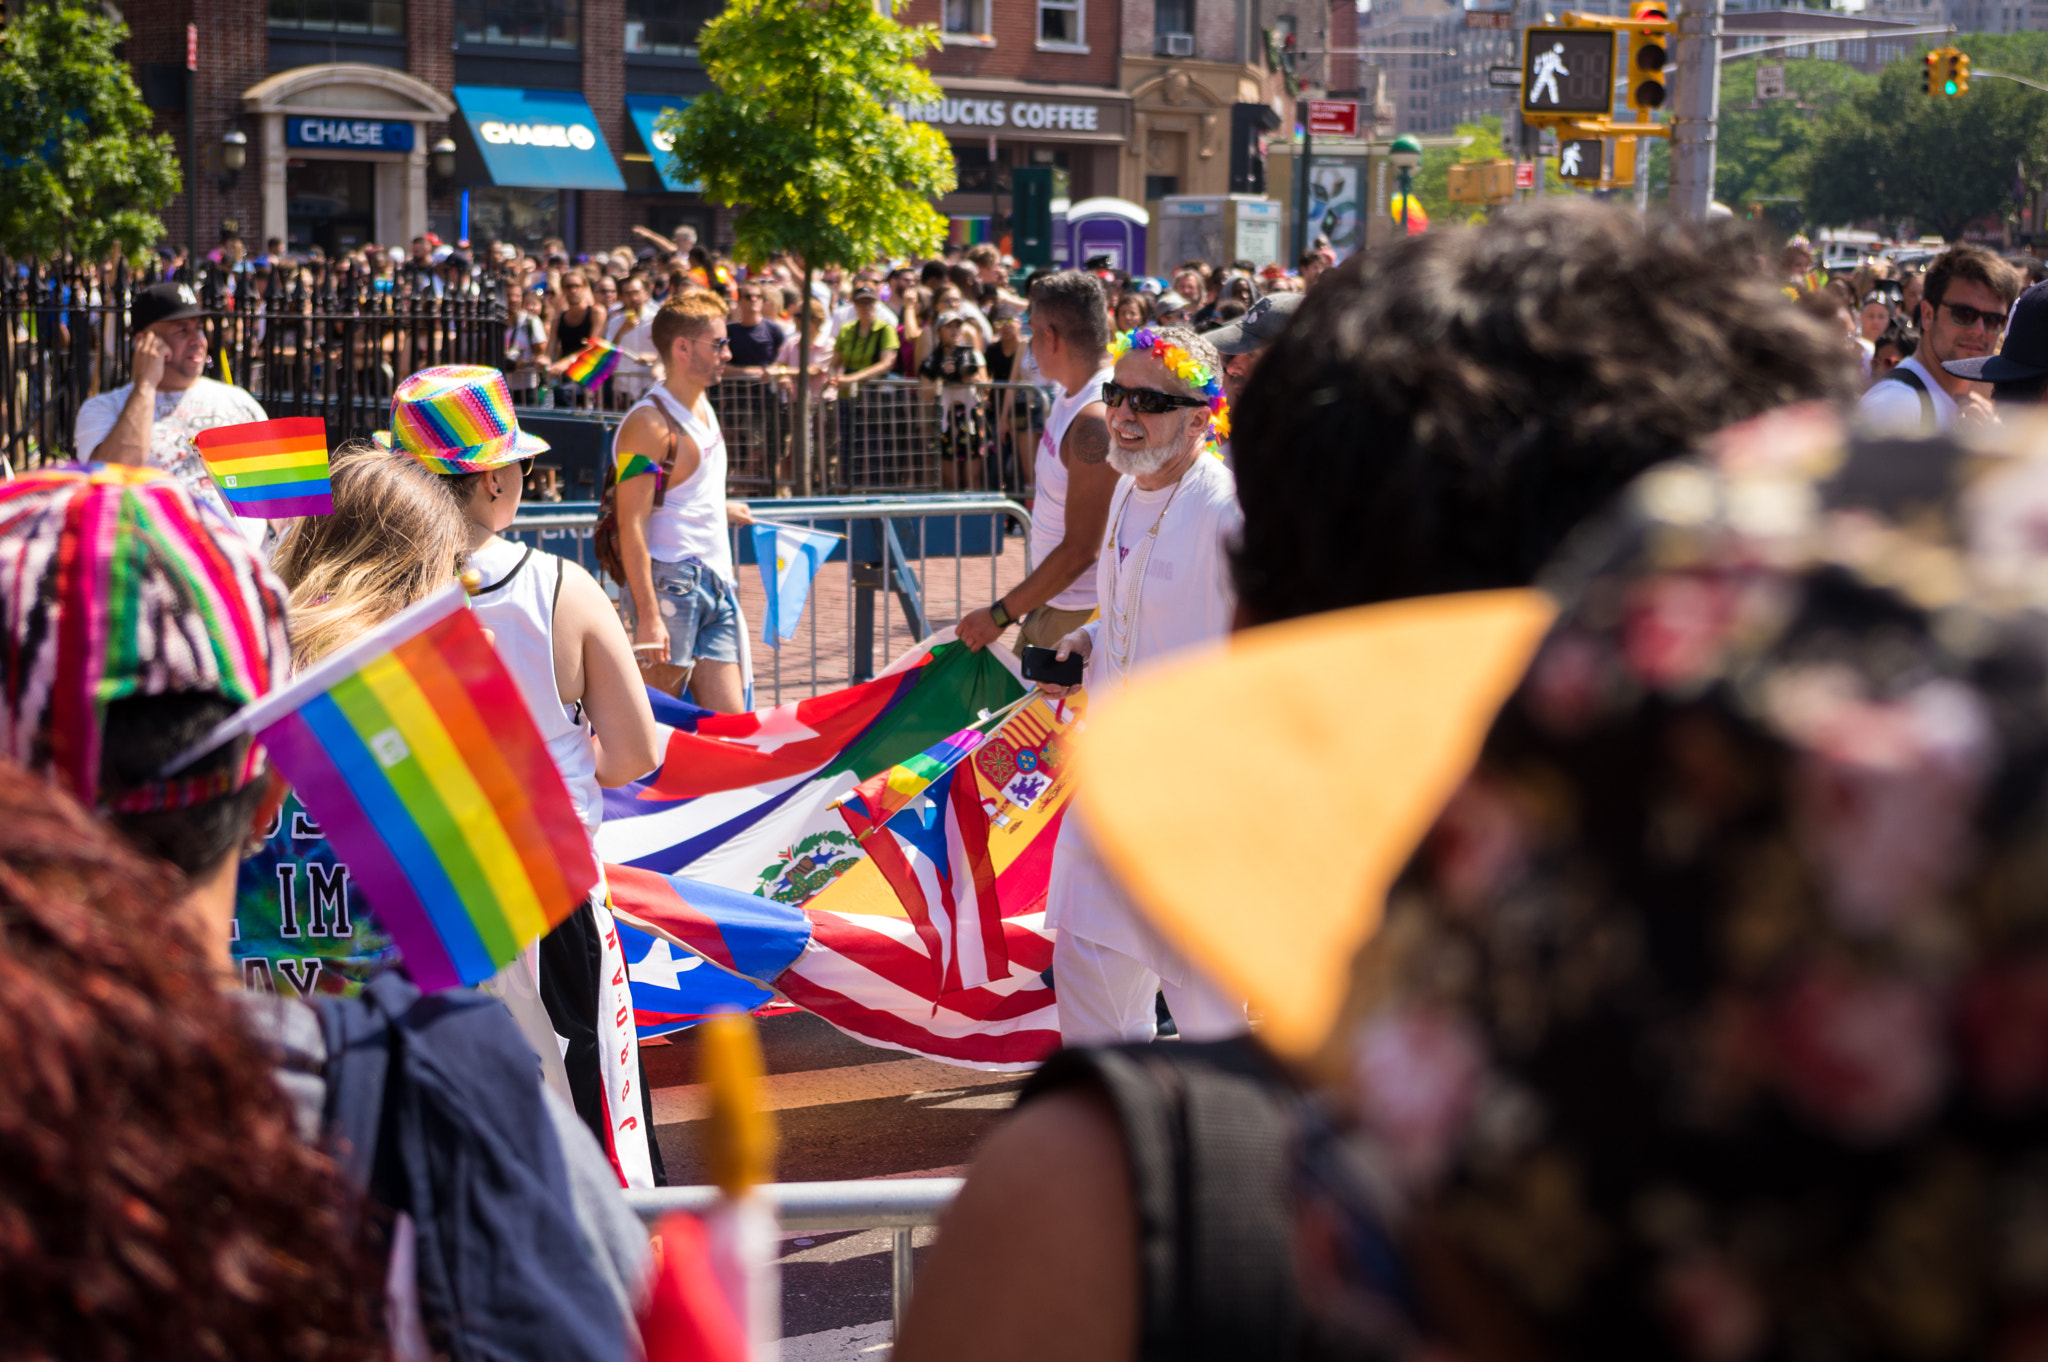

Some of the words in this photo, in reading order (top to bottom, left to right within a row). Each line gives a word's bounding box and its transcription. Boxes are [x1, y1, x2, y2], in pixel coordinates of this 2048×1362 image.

[891, 97, 1006, 127] ARBUCKS
[1011, 102, 1098, 130] COFFEE
[300, 119, 384, 145] CHASE
[276, 862, 353, 938] IM
